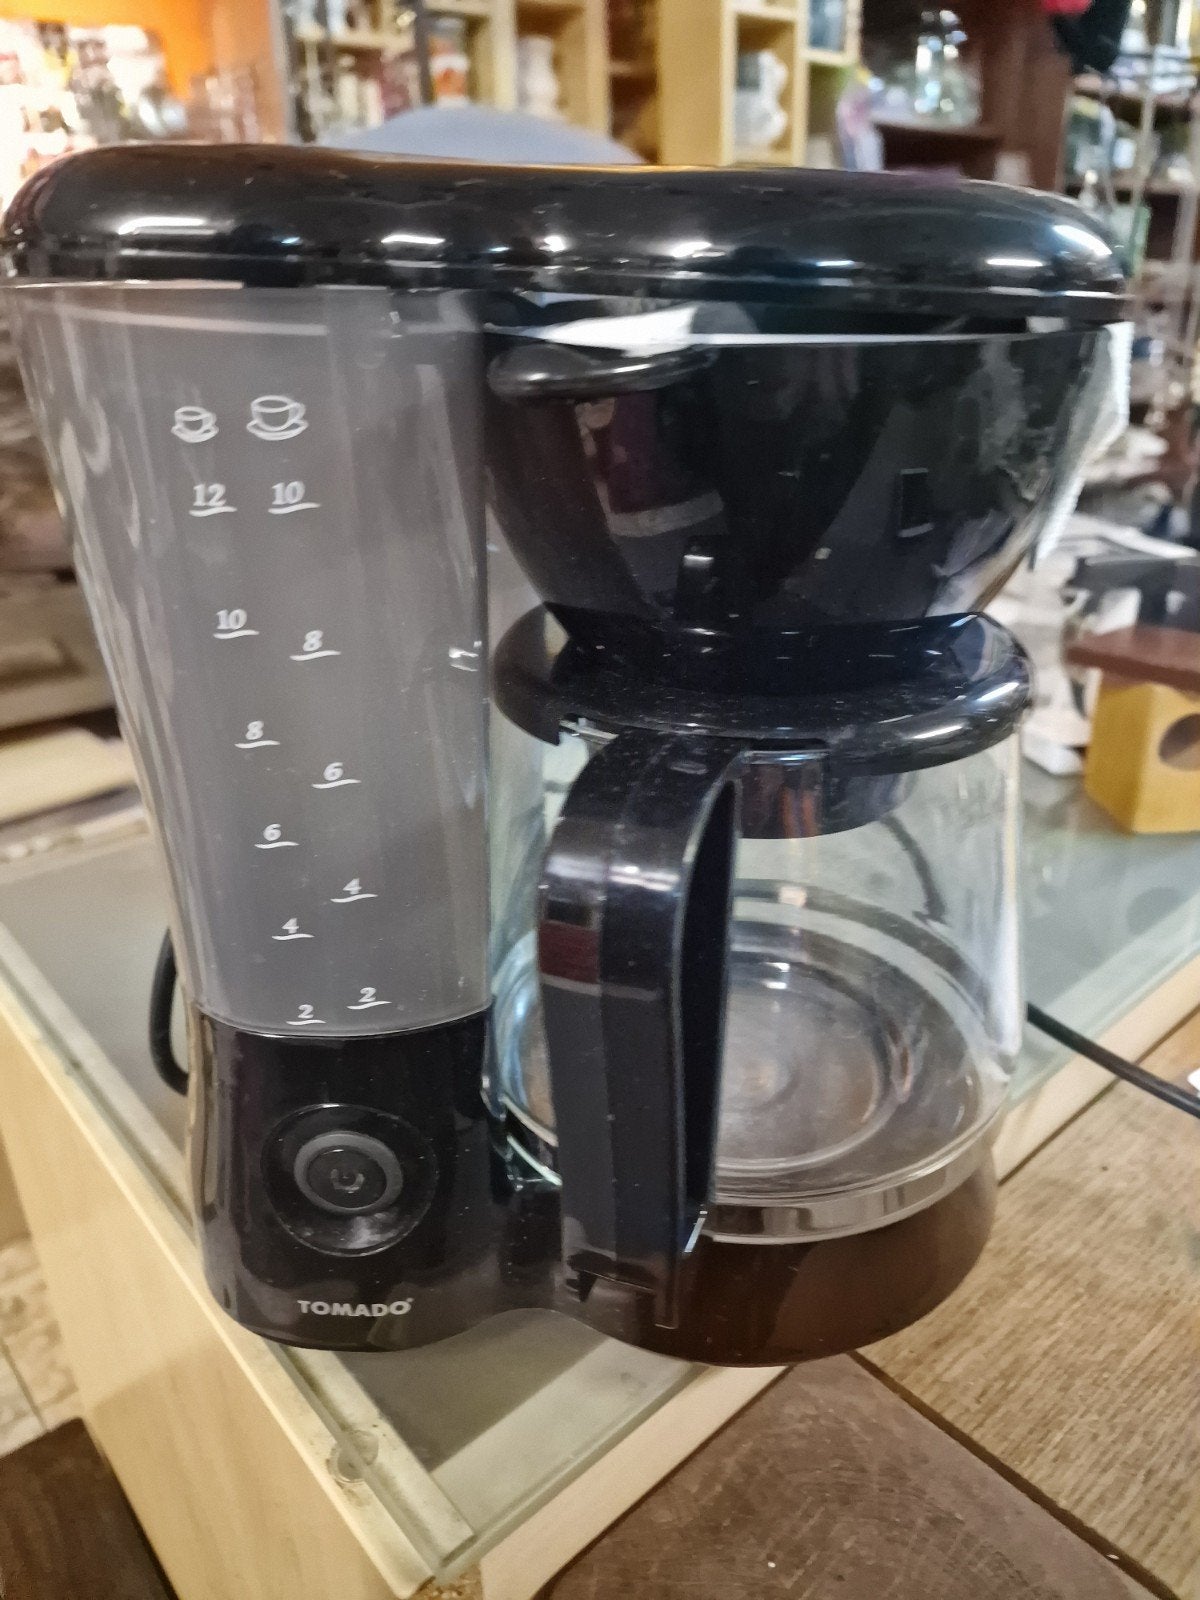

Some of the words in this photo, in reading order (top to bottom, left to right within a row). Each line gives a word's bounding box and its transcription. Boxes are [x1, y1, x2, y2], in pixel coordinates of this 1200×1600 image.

[193, 483, 226, 507] 12
[272, 481, 305, 505] 10
[216, 608, 247, 630] 10
[303, 629, 323, 651] 8
[245, 720, 264, 740] 8
[323, 761, 344, 781] 6
[263, 823, 281, 841] 6
[342, 878, 362, 895] 4
[281, 917, 299, 934] 4
[358, 987, 377, 1003] 2
[298, 1004, 314, 1019] 2
[297, 1299, 412, 1317] TOMADO
